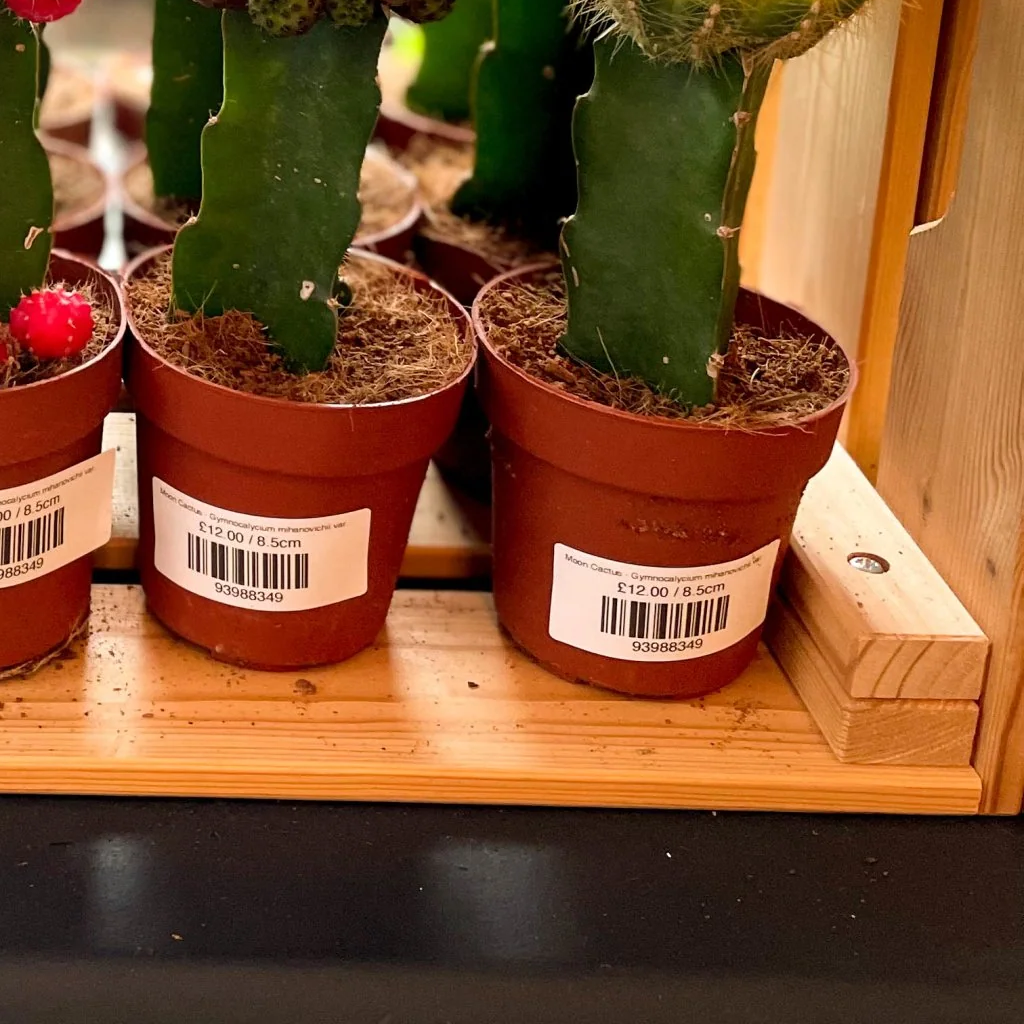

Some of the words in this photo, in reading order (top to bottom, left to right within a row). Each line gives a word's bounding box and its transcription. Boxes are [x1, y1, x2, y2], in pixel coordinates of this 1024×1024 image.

[15, 507, 21, 519] /
[23, 494, 60, 516] 8.5cm
[160, 487, 177, 502] Moon
[178, 499, 203, 517] Cactus
[209, 512, 276, 533] Gymnocalycium
[199, 521, 245, 544] £12.00
[248, 534, 254, 544] /
[257, 536, 302, 549] 8.5cm
[565, 553, 589, 569] Moon
[591, 563, 623, 576] Cactus
[631, 572, 703, 583] Gymnocalycium
[214, 582, 284, 603] 93988349
[617, 582, 669, 598] £12.00
[673, 586, 680, 597] /
[682, 582, 725, 597] 8.5cm
[632, 638, 704, 653] 93988349
